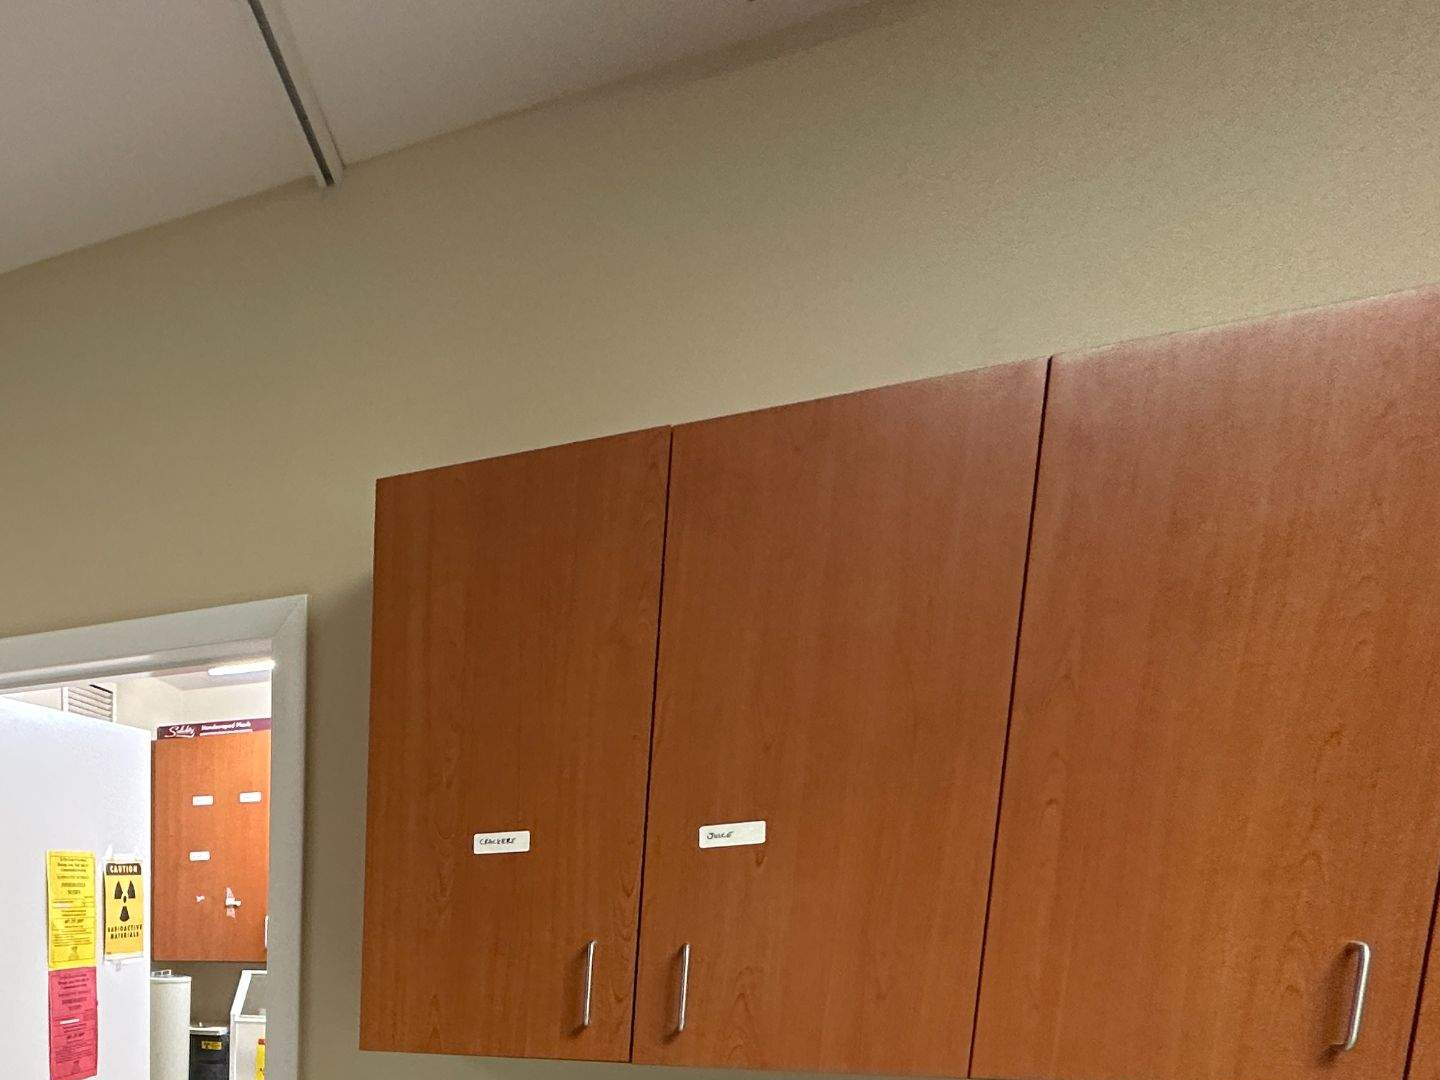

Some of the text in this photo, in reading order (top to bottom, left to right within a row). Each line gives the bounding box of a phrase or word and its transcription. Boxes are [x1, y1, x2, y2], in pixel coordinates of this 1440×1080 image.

[110, 865, 138, 874] CAUTION
[107, 924, 143, 933] RADIOACTIVE
[110, 932, 139, 940] MATERIALS
